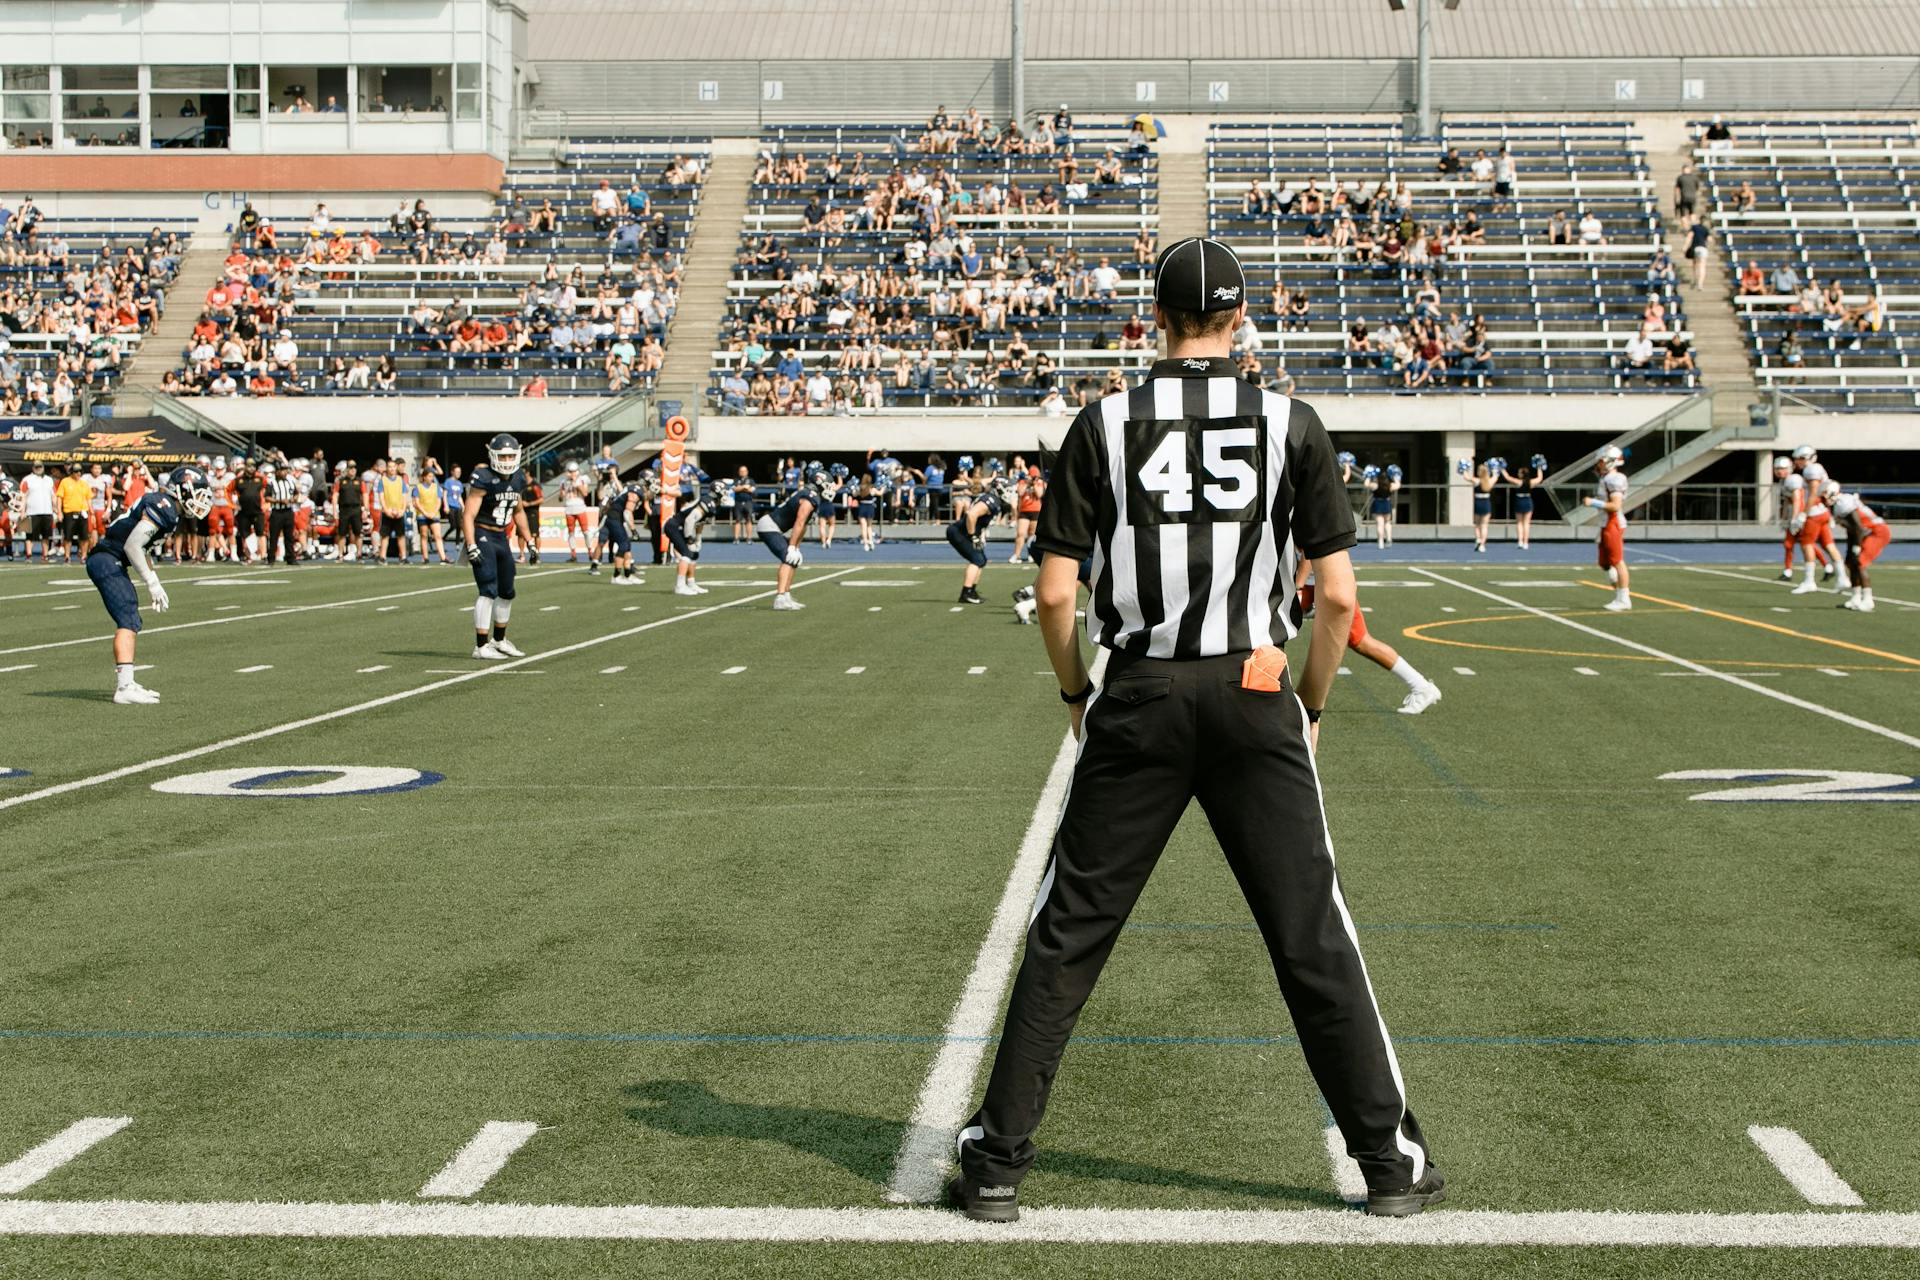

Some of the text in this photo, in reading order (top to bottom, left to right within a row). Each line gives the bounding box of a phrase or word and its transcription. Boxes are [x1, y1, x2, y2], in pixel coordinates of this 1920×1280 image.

[701, 83, 715, 99] H
[205, 192, 220, 209] G
[232, 192, 247, 209] H
[1138, 428, 1258, 512] 45
[1656, 768, 1920, 804] 2
[979, 1186, 1016, 1197] Reebok
